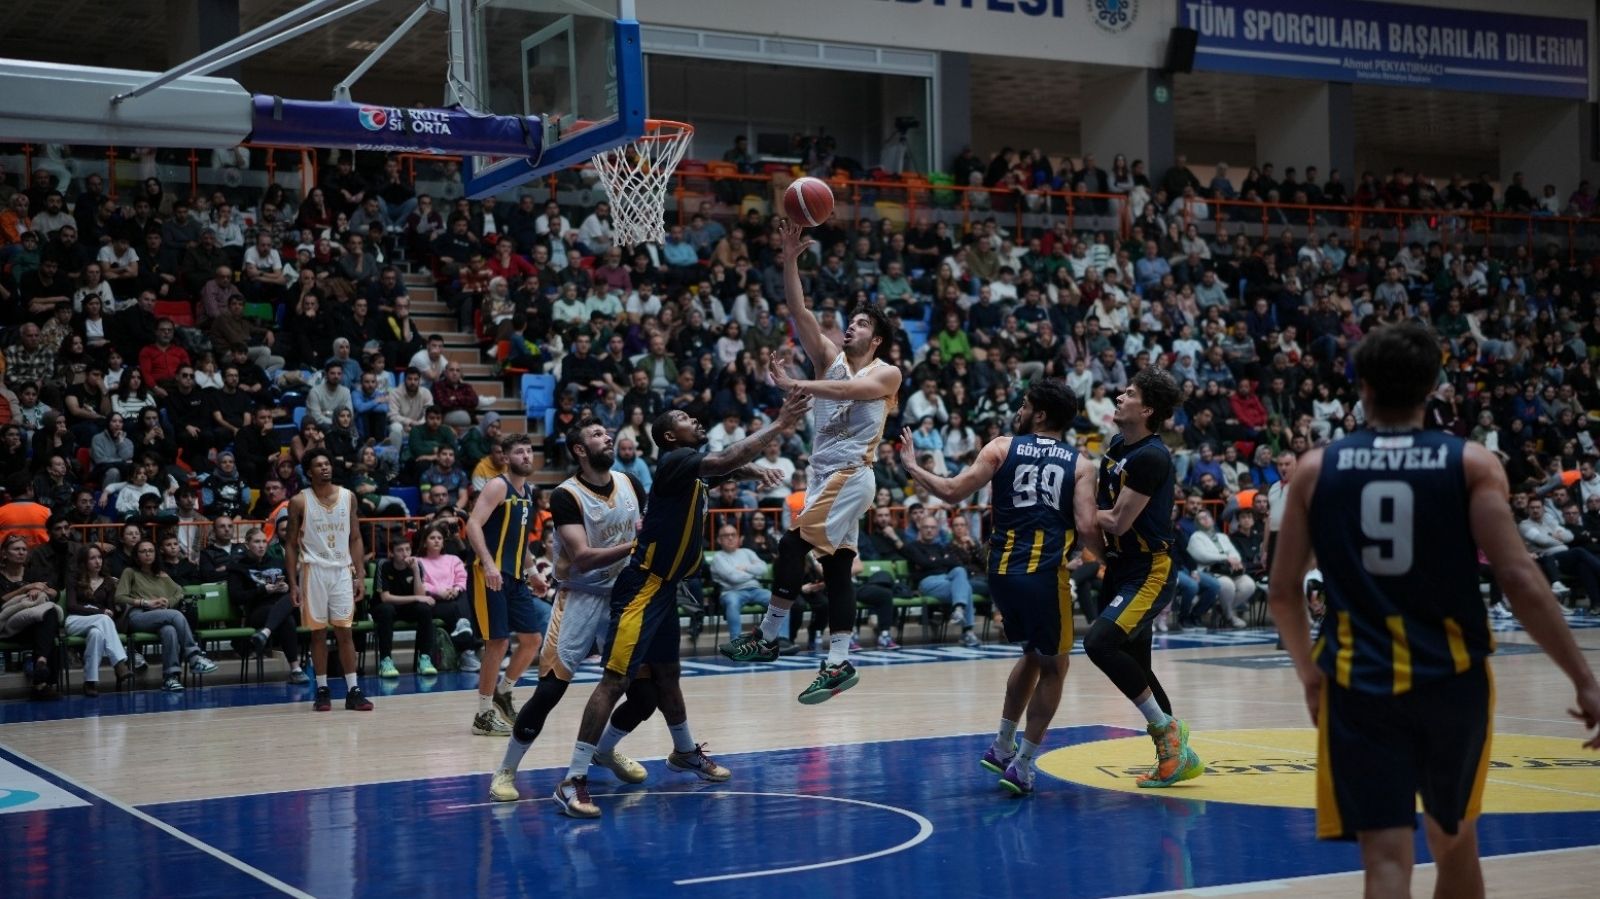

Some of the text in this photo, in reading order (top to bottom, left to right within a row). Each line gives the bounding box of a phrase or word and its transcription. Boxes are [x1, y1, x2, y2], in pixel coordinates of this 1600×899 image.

[1186, 1, 1235, 38] TÜM
[1243, 9, 1381, 51] SPORCULARA
[1388, 22, 1500, 61] BAŞARILAR
[1342, 57, 1373, 70] Ahmet
[1336, 443, 1448, 470] BOZVELİ
[1013, 463, 1065, 510] 99
[315, 522, 345, 533] KONYA
[600, 519, 633, 539] KONYA
[1361, 480, 1414, 576] 9
